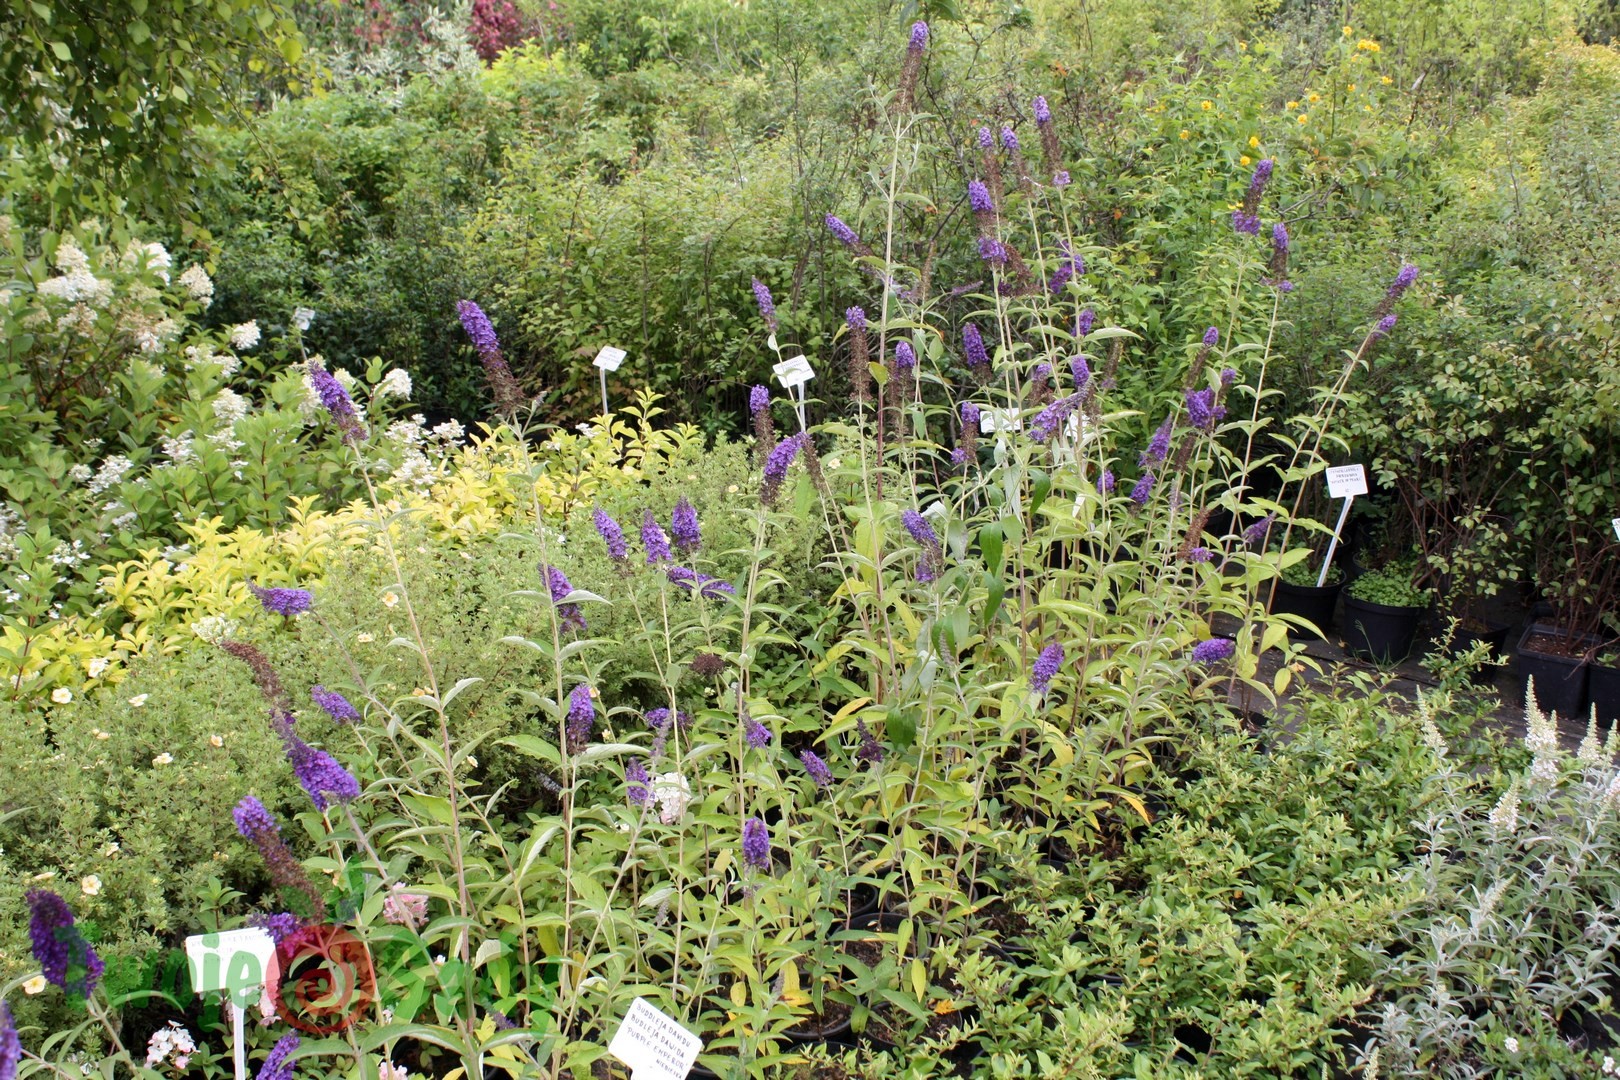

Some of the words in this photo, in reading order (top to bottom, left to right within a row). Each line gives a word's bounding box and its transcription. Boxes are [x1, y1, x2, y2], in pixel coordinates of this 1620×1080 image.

[636, 1003, 667, 1030] BUDDLEJA
[630, 1013, 659, 1039] BUDLEJA
[660, 1035, 685, 1059] DAWIDA
